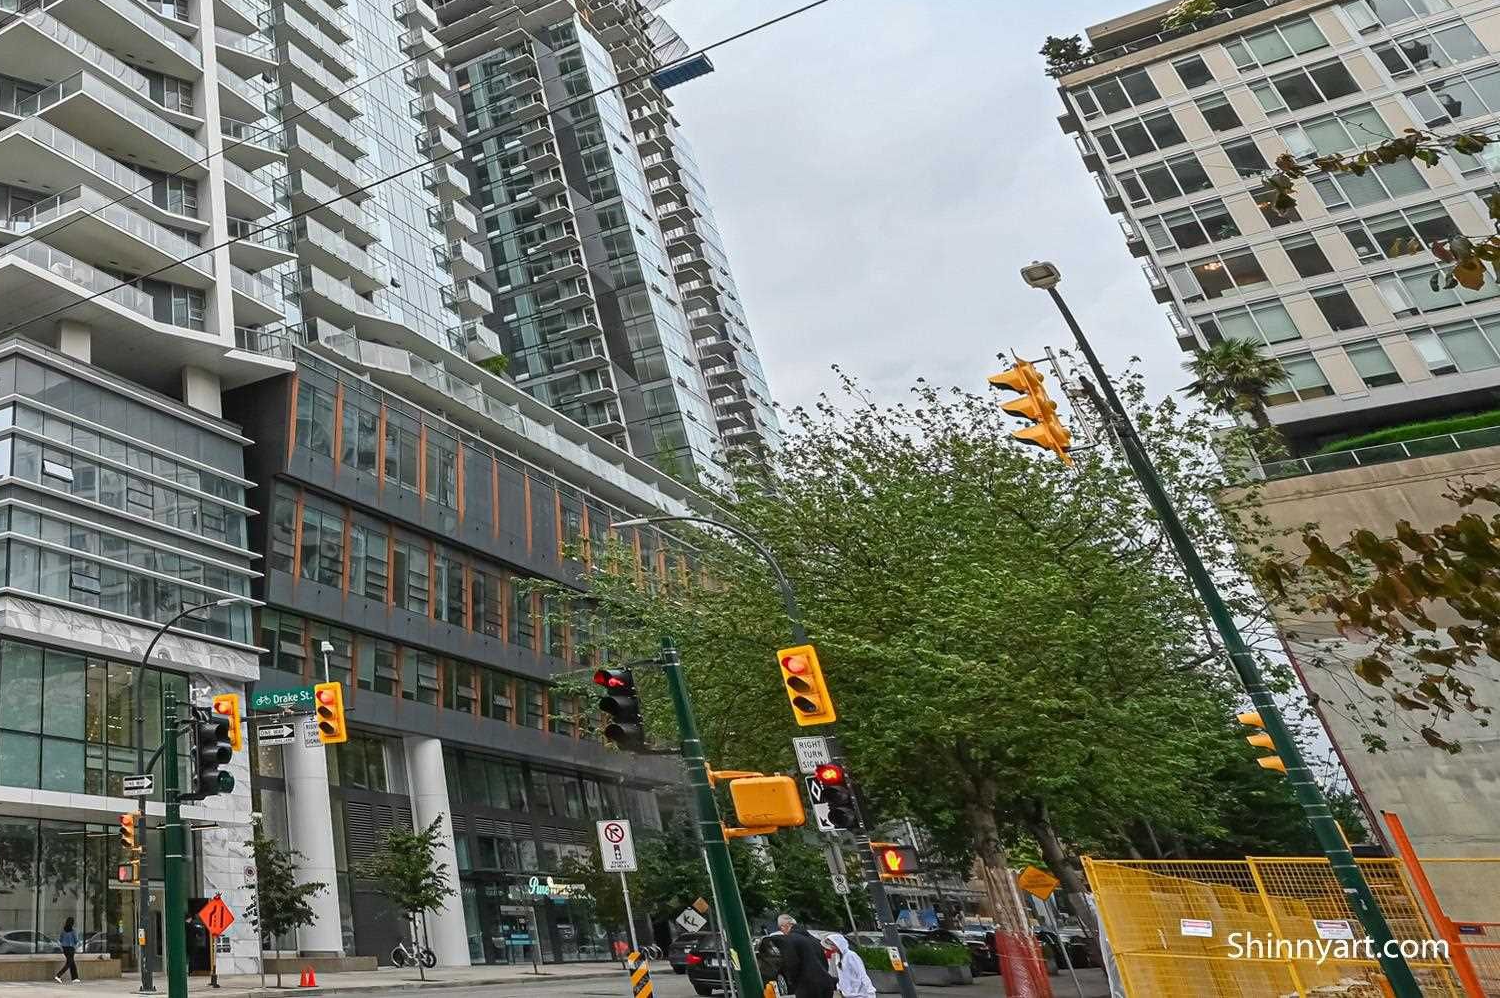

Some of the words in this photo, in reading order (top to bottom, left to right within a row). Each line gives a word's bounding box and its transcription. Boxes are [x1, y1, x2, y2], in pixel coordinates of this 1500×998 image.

[273, 692, 299, 704] Drake
[300, 690, 313, 701] St.
[799, 741, 821, 749] RIGHT
[529, 876, 550, 895] Pure
